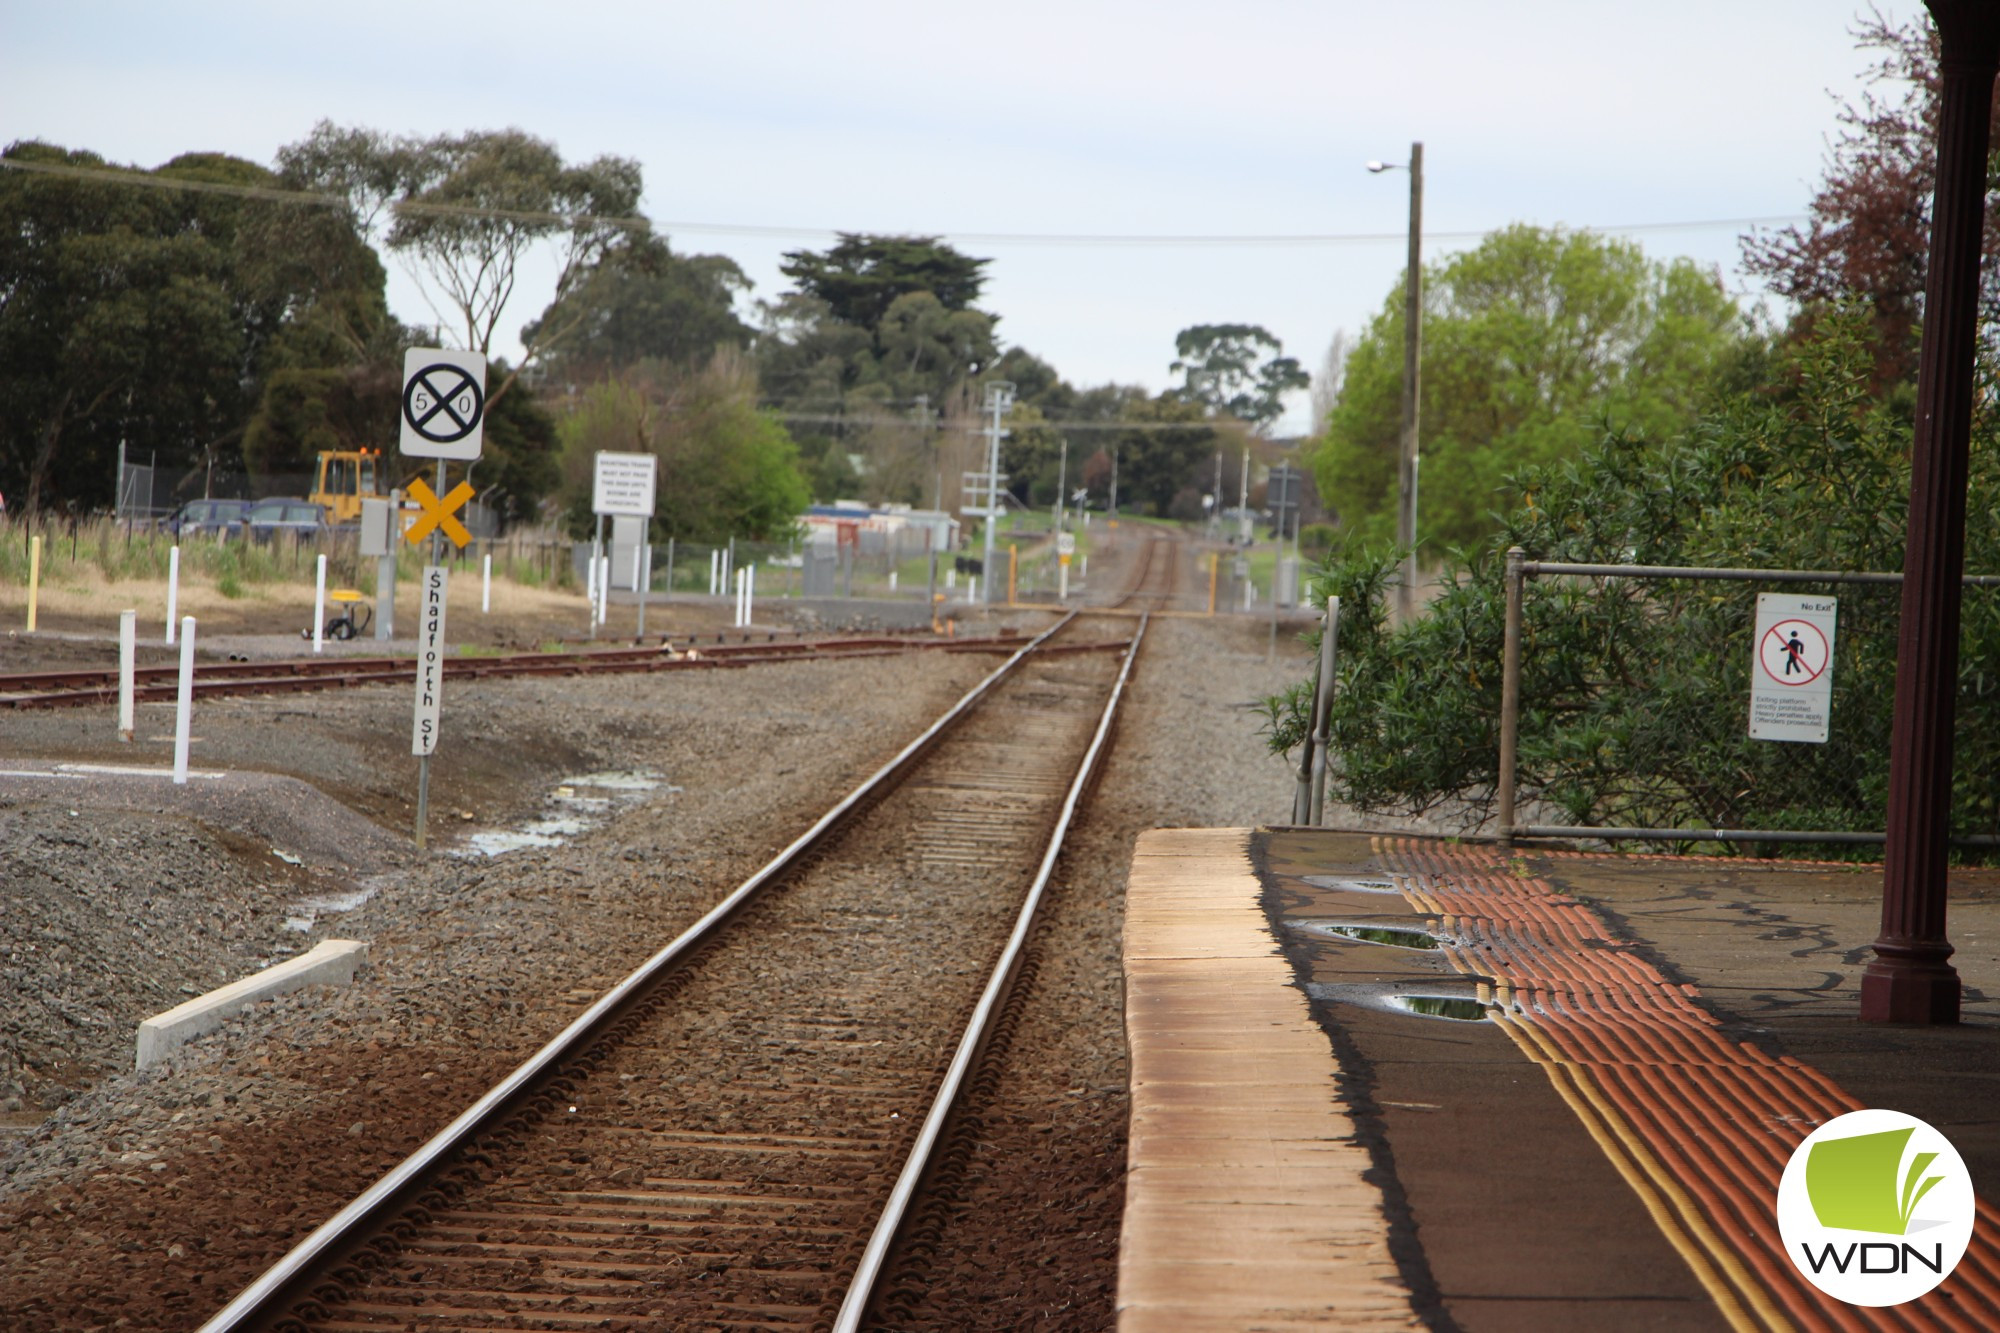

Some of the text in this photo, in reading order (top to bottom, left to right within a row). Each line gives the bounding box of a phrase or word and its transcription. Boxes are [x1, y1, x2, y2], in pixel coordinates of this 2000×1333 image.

[1801, 603, 1814, 611] No
[421, 572, 441, 748] Shadforth St
[1756, 696, 1807, 705] Exiting platform
